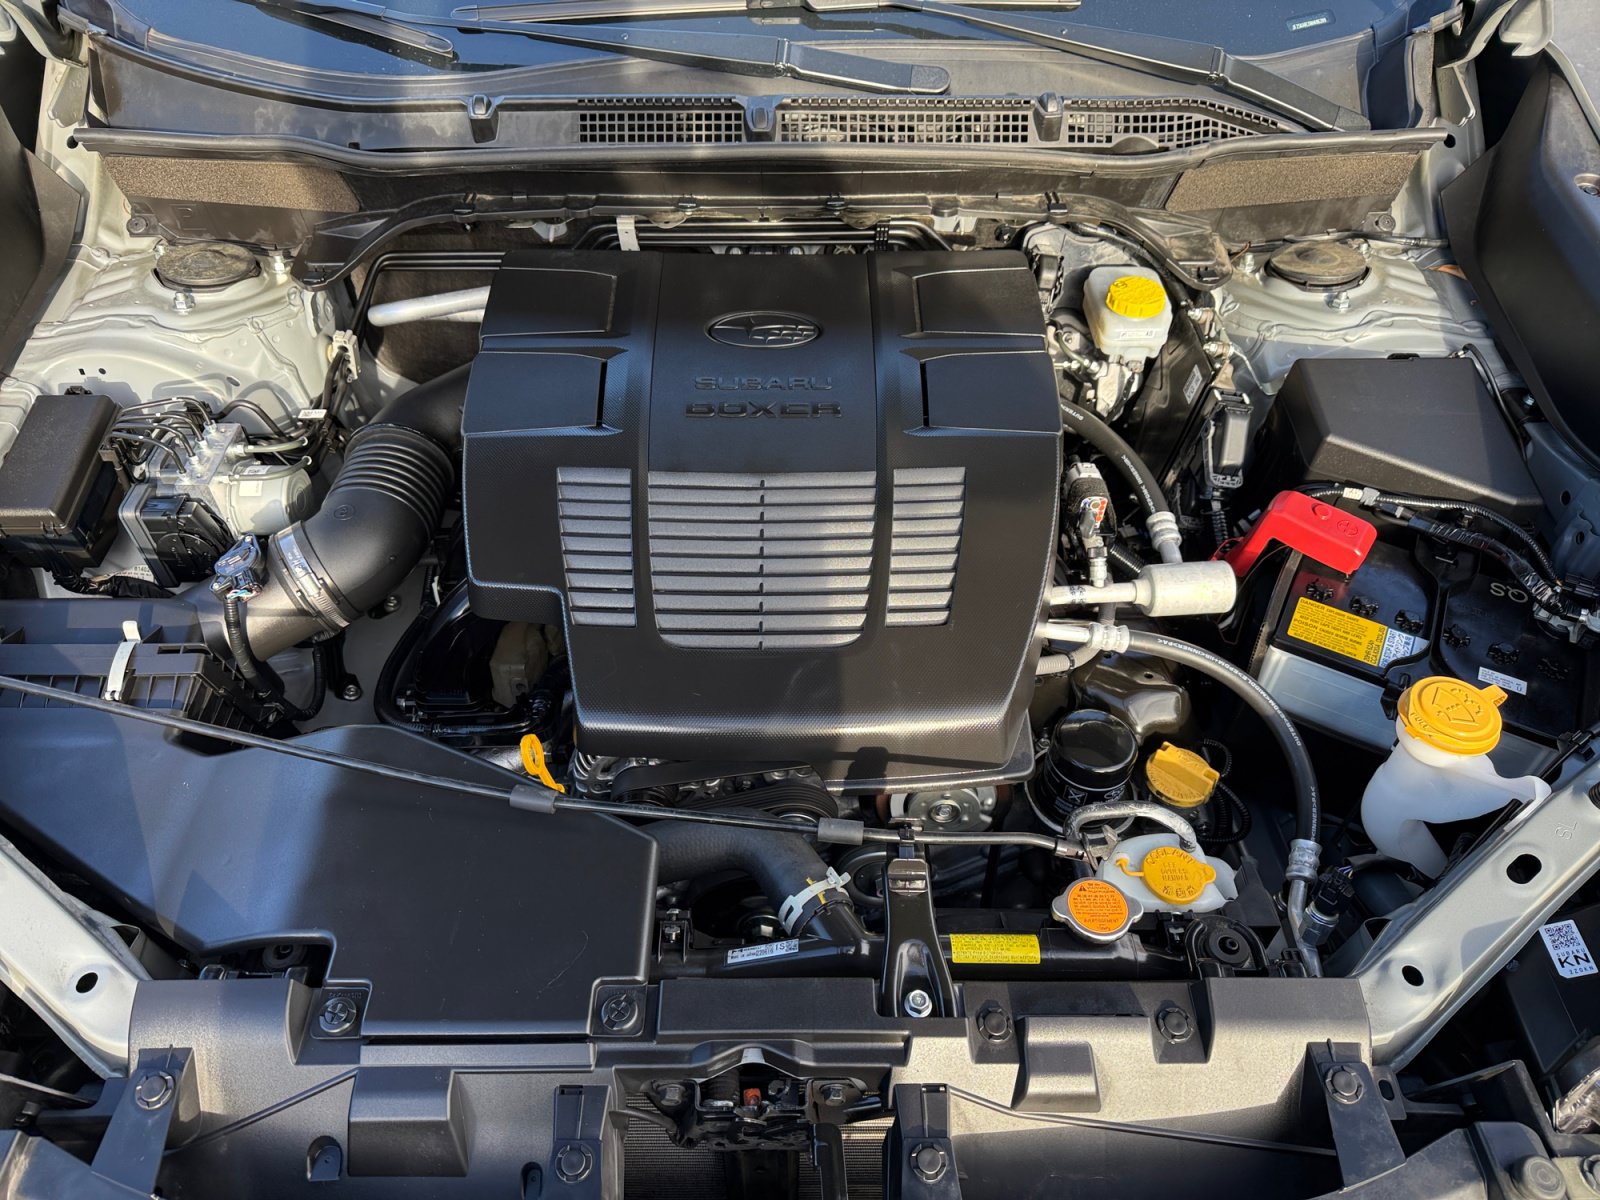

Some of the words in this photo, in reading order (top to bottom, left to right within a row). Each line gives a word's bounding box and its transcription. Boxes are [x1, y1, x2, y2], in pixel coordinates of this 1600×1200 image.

[694, 376, 833, 391] SUBARU
[684, 401, 843, 418] BOXER
[1300, 599, 1325, 611] DANGER
[1294, 619, 1318, 630] POISON
[1556, 948, 1586, 958] SUBARU
[1558, 953, 1591, 968] KN
